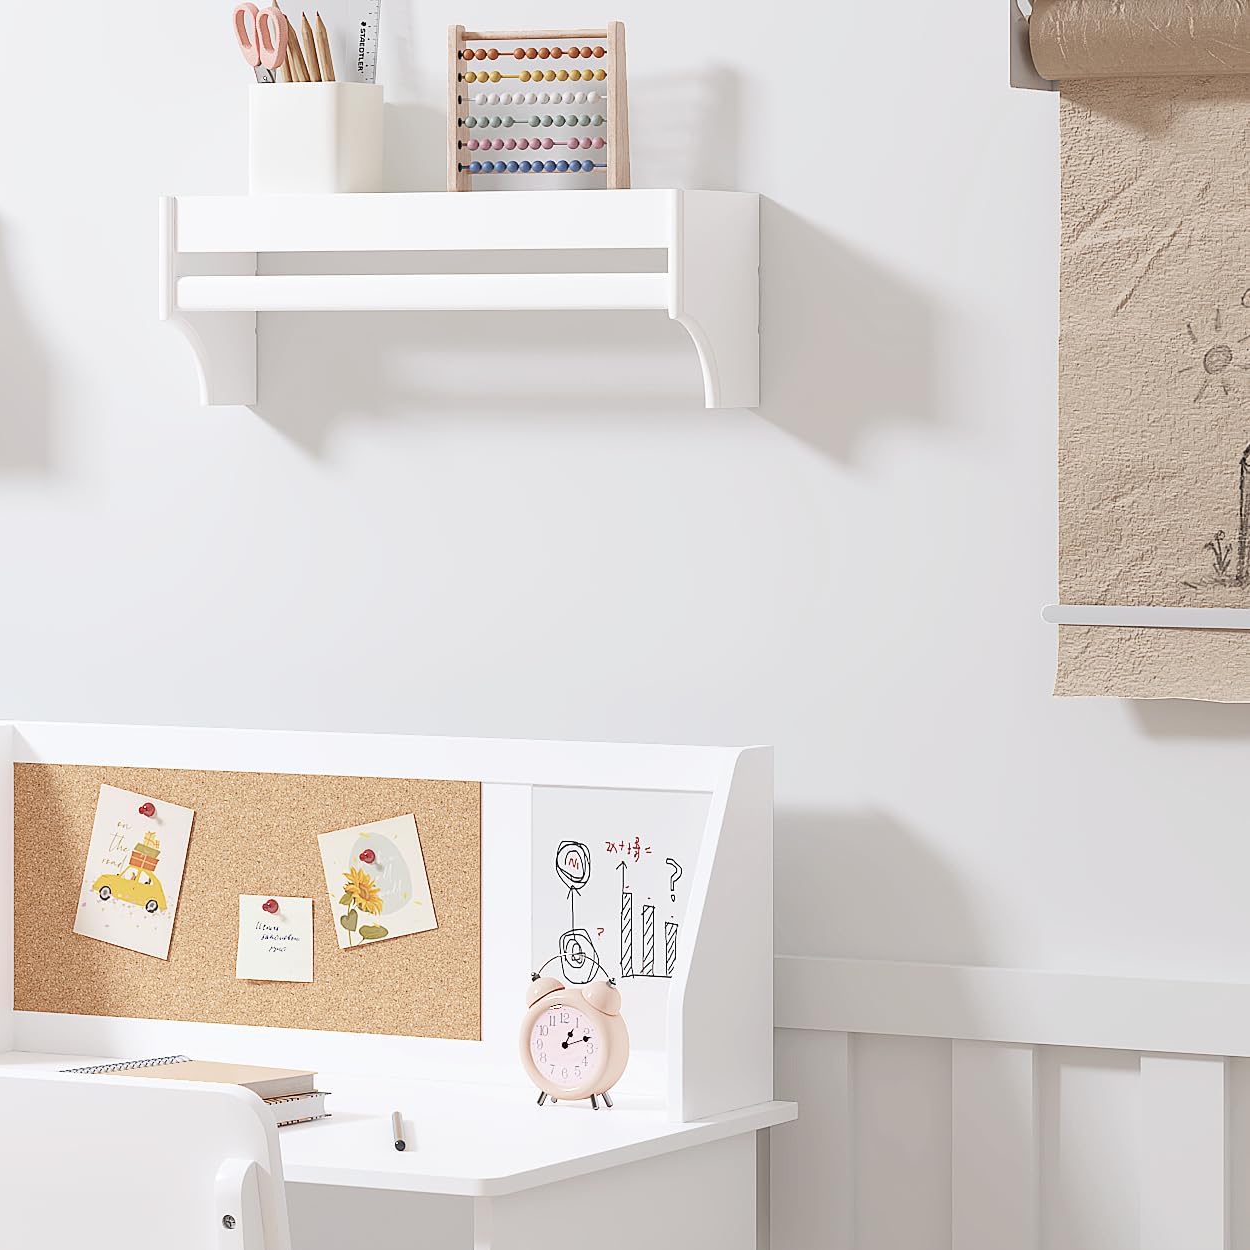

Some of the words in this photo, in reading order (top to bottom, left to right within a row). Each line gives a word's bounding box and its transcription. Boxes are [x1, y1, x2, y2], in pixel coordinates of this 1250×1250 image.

[358, 28, 366, 72] STAEDTLER
[560, 1012, 570, 1024] 12
[539, 1025, 548, 1036] 10
[536, 1039, 543, 1050] 9
[587, 1043, 594, 1054] 3
[540, 1053, 547, 1064] 8
[582, 1056, 588, 1066] 4
[550, 1064, 556, 1074] 7
[562, 1068, 568, 1079] 6
[574, 1066, 581, 1076] 5
